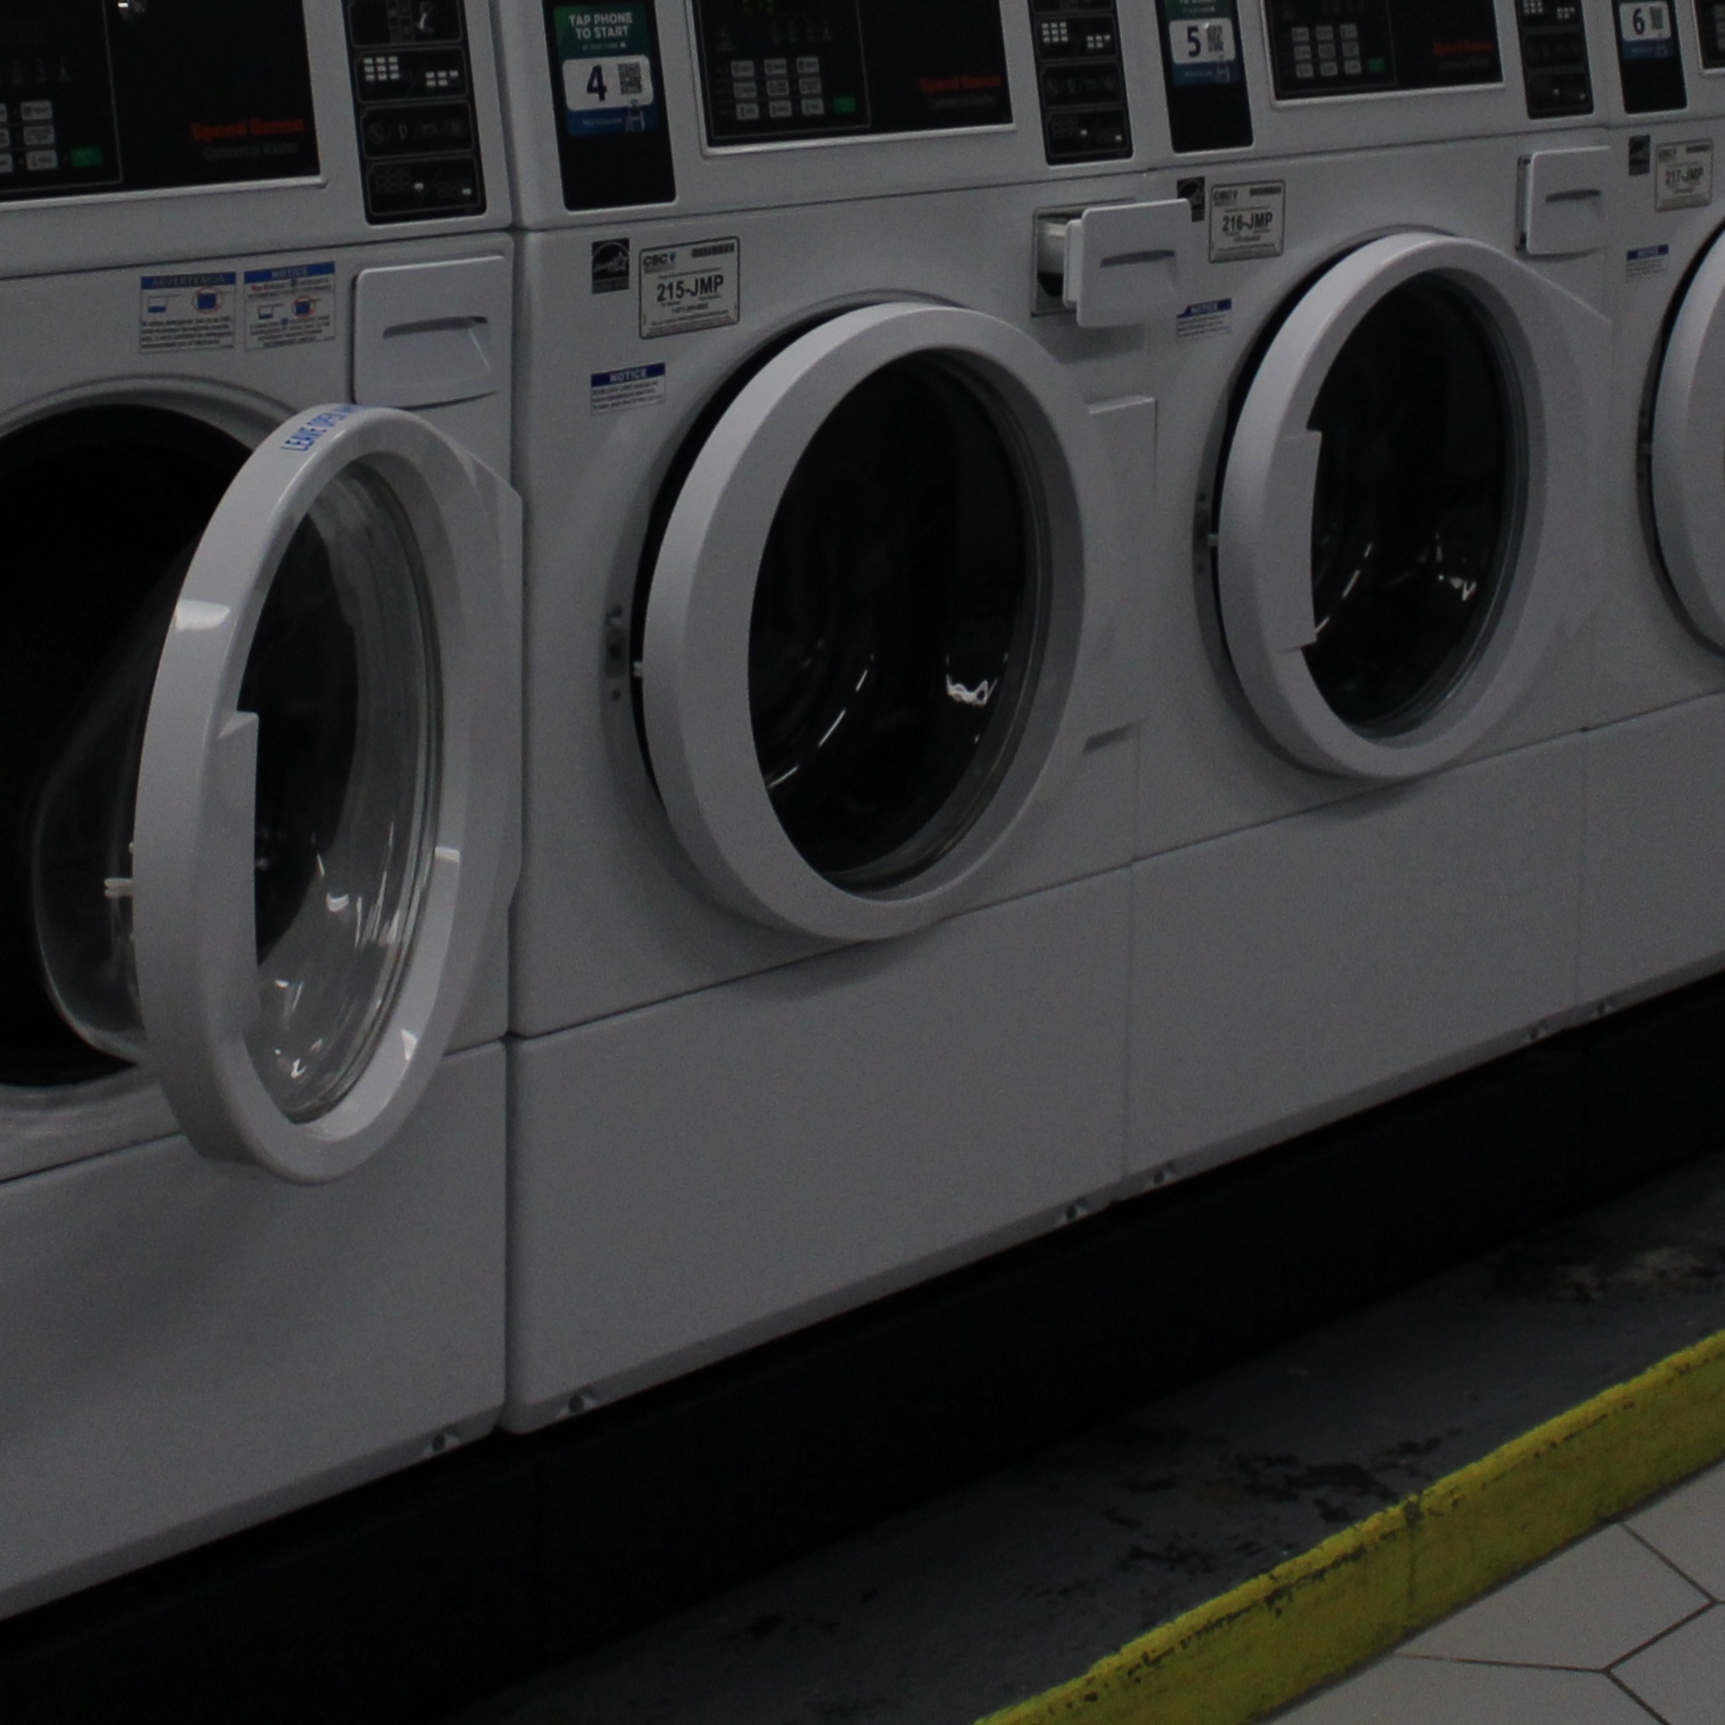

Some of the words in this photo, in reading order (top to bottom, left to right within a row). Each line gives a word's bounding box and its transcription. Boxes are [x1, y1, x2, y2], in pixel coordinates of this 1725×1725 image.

[569, 13, 592, 27] TAP
[594, 11, 633, 25] PHONE
[1633, 8, 1645, 35] 6
[575, 27, 592, 39] TO
[594, 25, 629, 37] START
[1187, 26, 1201, 58] 5
[586, 65, 607, 102] 4
[249, 117, 306, 137] Queen
[1222, 213, 1273, 231] 216-JMP
[151, 275, 226, 288] ADVERTENCIA
[656, 274, 724, 301] 215-JMP
[609, 367, 648, 383] NOTICE
